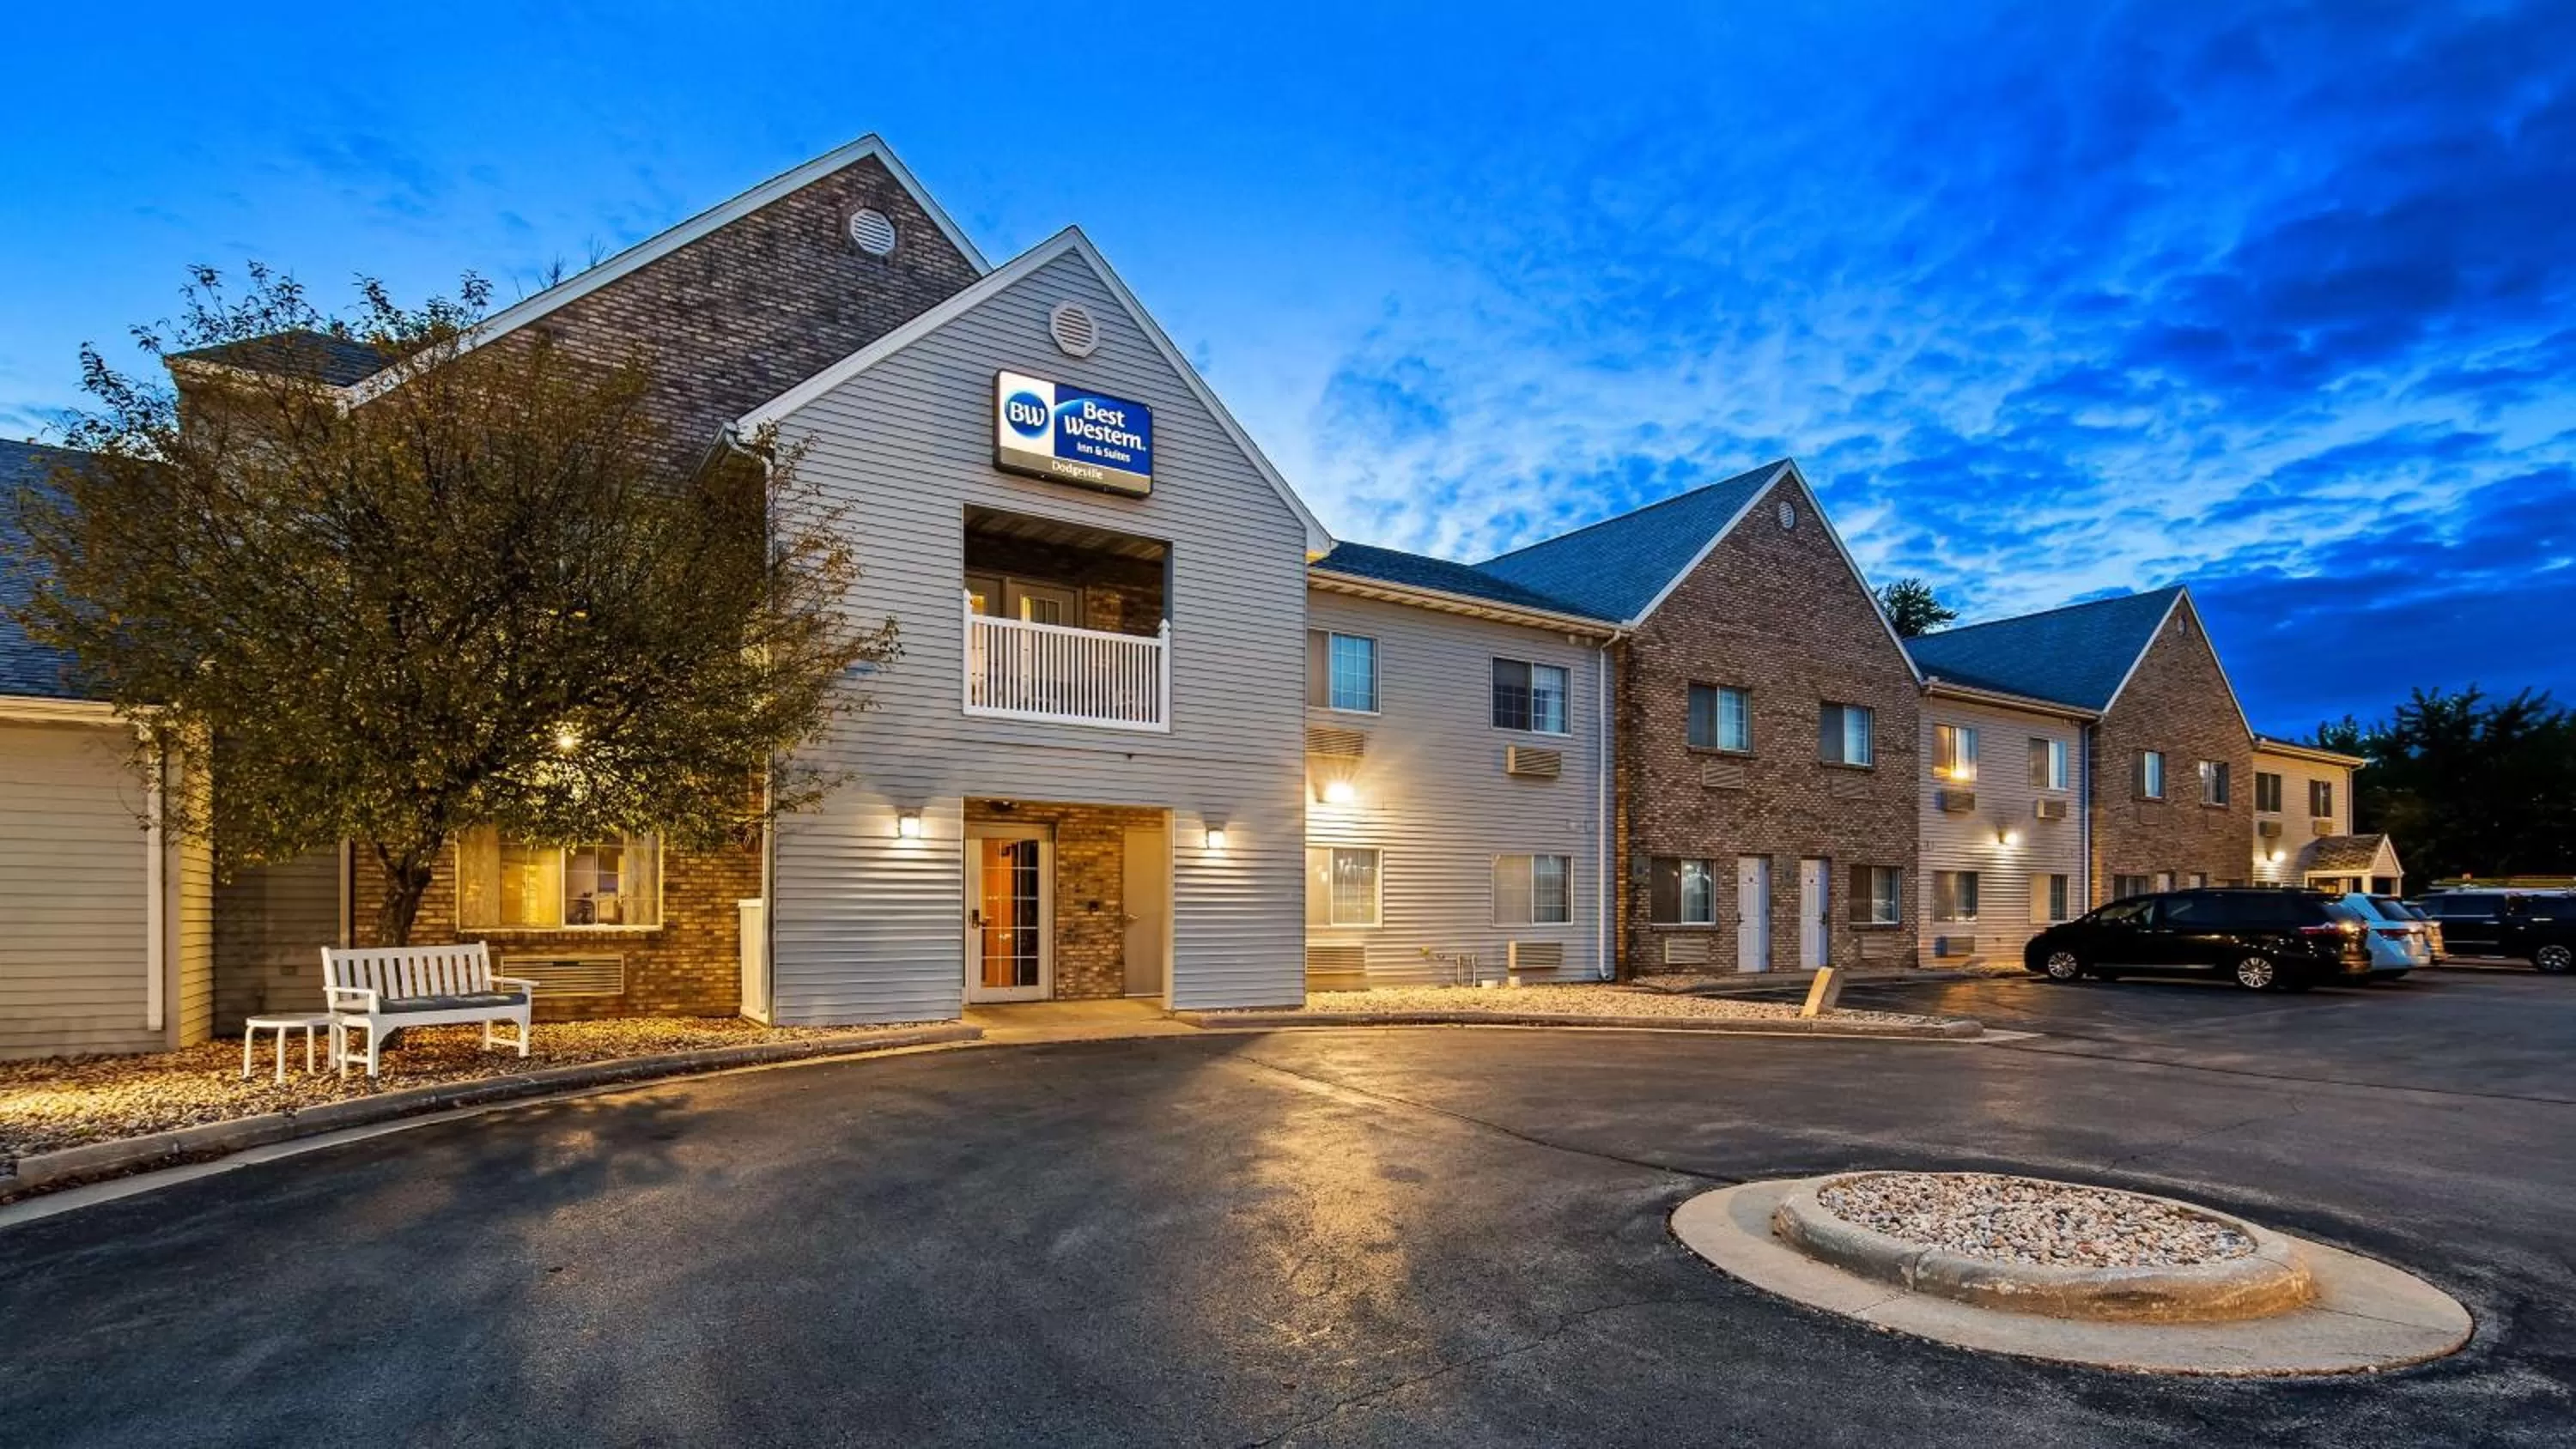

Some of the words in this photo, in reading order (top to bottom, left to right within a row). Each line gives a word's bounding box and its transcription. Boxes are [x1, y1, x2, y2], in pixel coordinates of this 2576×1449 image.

[1009, 402, 1045, 427] BW
[1084, 401, 1125, 428] Best
[1077, 442, 1093, 454] Inn
[1095, 446, 1103, 456] &
[1103, 447, 1131, 463] Suites
